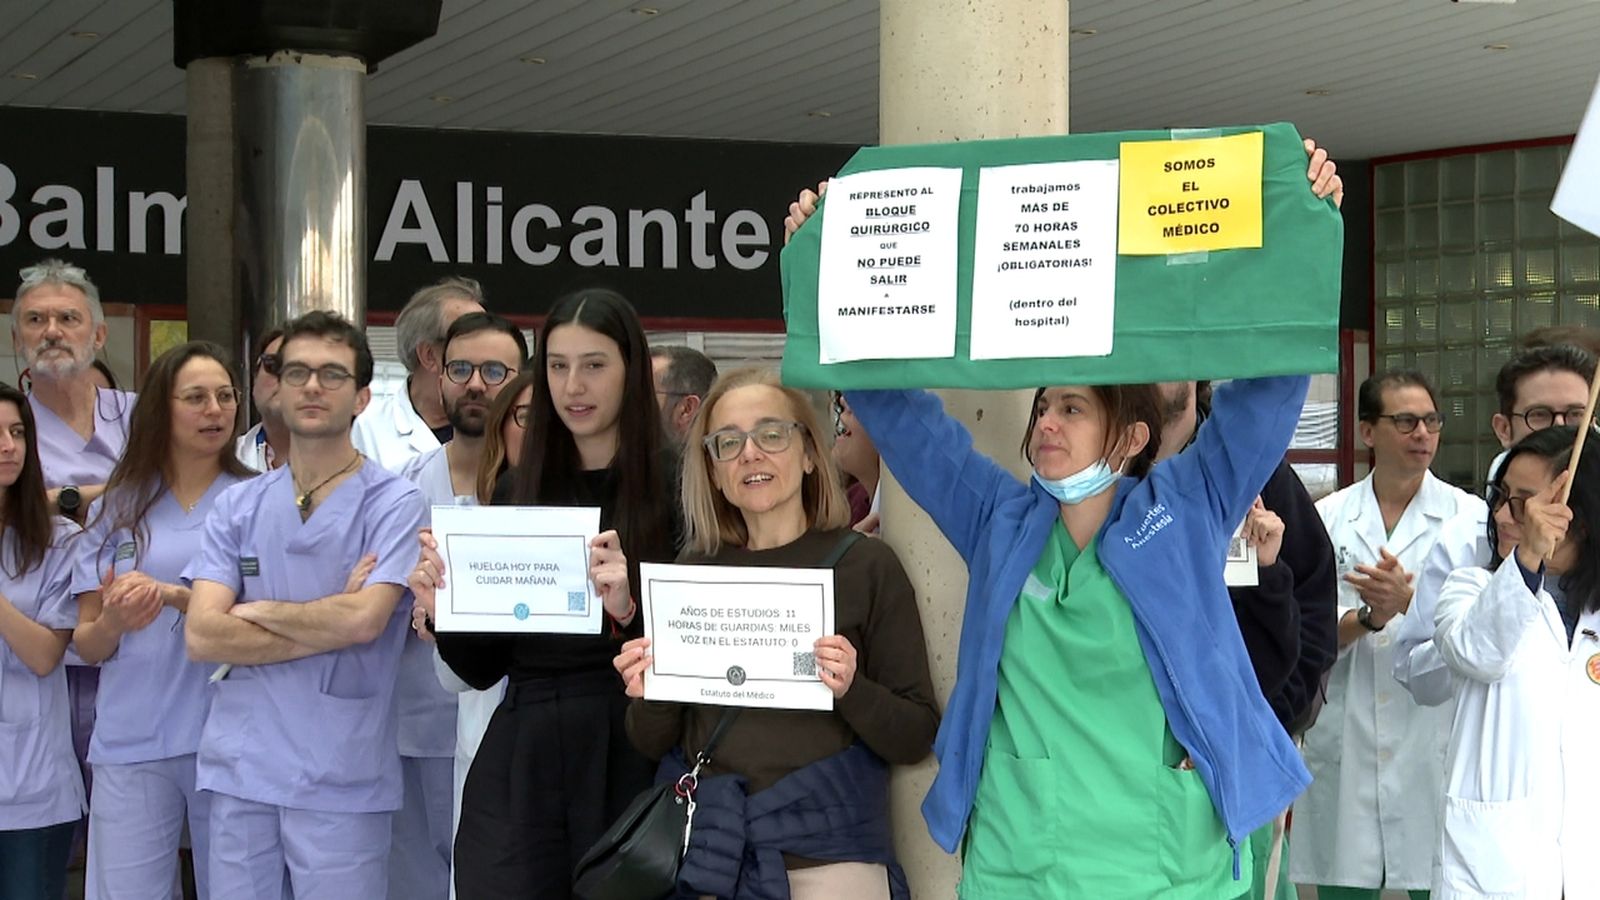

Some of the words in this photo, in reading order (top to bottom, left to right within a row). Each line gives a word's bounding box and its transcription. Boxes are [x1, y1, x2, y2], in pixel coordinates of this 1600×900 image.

[1164, 158, 1215, 172] SOMOS
[1011, 183, 1081, 194] trabajamos
[1182, 181, 1199, 192] EL
[849, 188, 918, 200] REPRESENTO
[920, 187, 934, 195] AL
[865, 205, 917, 217] BLOQUE
[1052, 202, 1069, 211] DE
[1148, 198, 1230, 216] COLECTIVO
[373, 179, 770, 270] Alicante
[850, 221, 930, 235] QUIRÚRGICO
[1015, 224, 1029, 233] 70
[1033, 222, 1078, 232] HORAS
[1163, 222, 1220, 237] MÉDICO
[1003, 239, 1081, 251] SEMANALES
[857, 258, 876, 268] NO
[879, 255, 921, 267] PUEDE
[997, 258, 1093, 272] ¡OBLIGATORIAS!
[870, 274, 907, 285] SALIR
[838, 304, 936, 316] MANIFESTARSE
[1009, 299, 1054, 311] (dentro
[1058, 297, 1077, 306] del
[1015, 316, 1070, 328] hospital)
[469, 562, 509, 571] HUELGA
[510, 563, 531, 571] HOY
[533, 563, 560, 571] PARA
[475, 575, 512, 584] CUIDAR
[515, 575, 557, 585] MAÑANA
[680, 605, 708, 617] AÑOS
[710, 608, 724, 617] DE
[786, 609, 796, 618] 11
[668, 620, 702, 631] HORAS
[704, 622, 717, 631] DE
[779, 623, 811, 632] MILES
[680, 635, 700, 644] VOZ
[702, 636, 716, 645] EN
[719, 637, 731, 646] EL
[700, 688, 731, 698] Estatuto
